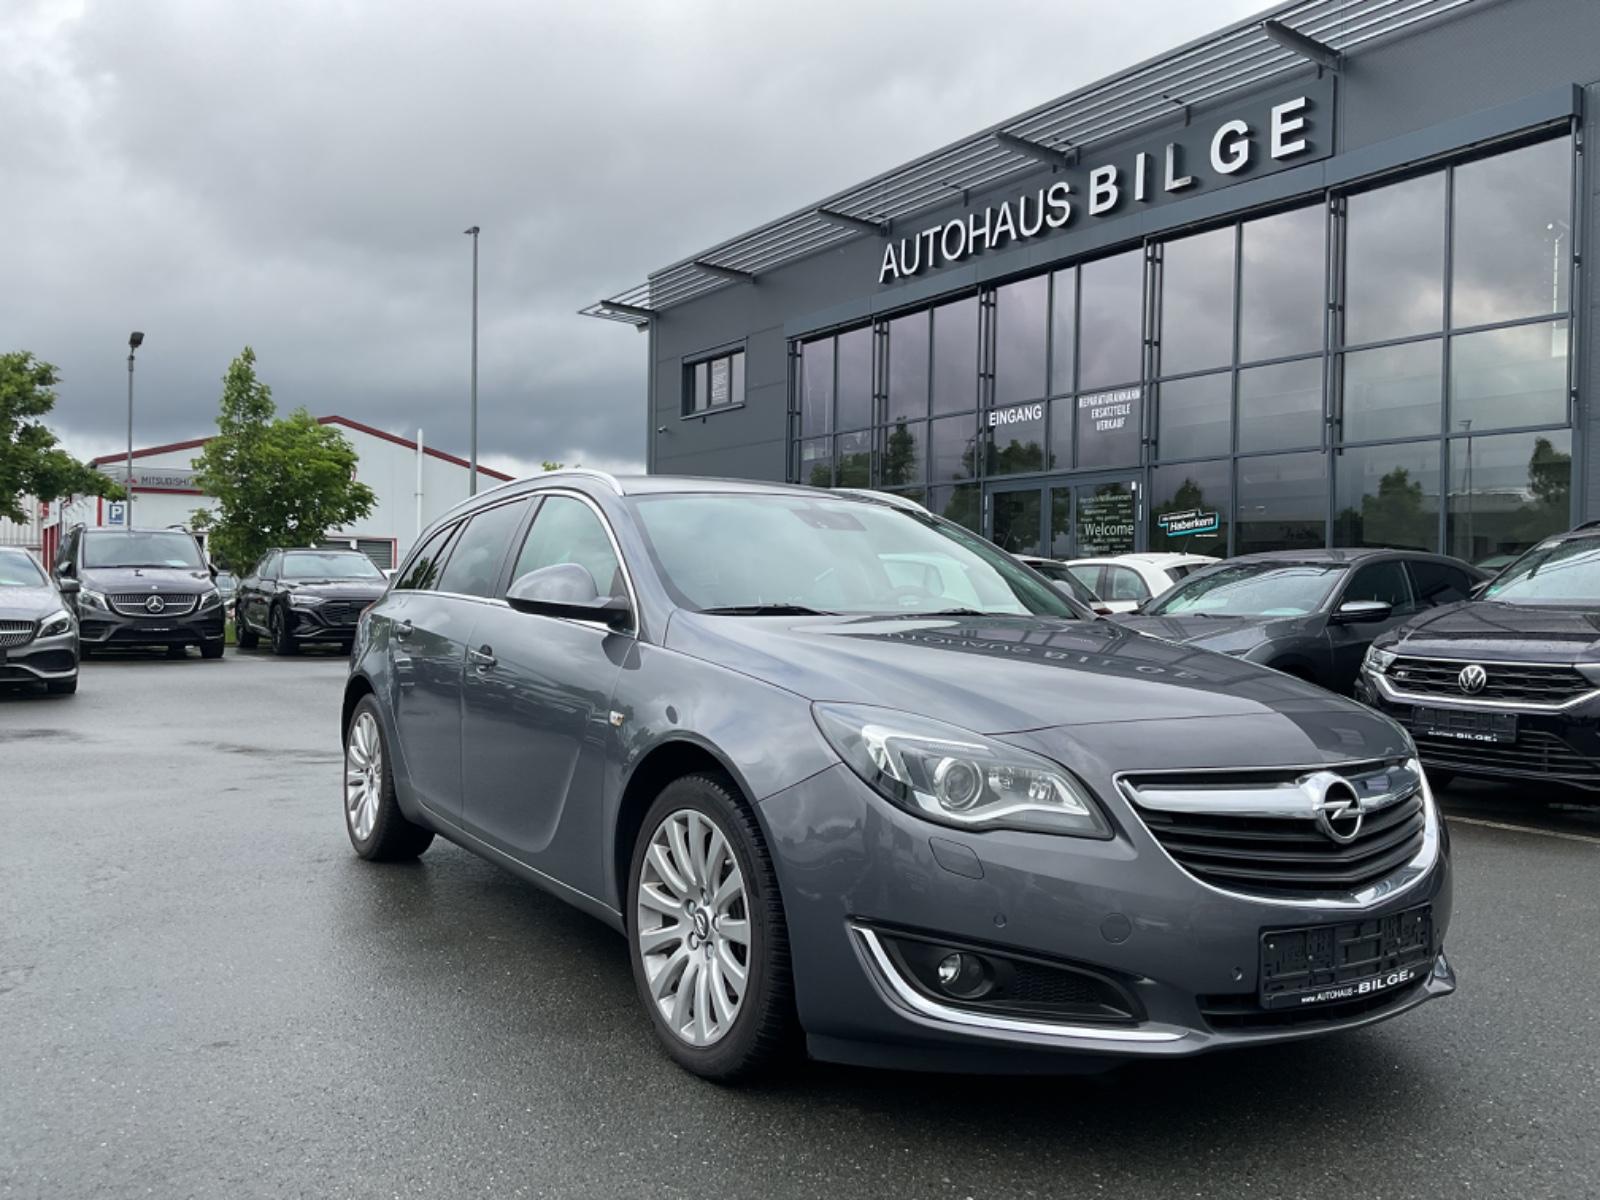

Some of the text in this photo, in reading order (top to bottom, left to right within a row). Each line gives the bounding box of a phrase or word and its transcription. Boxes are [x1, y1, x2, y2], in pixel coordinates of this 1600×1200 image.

[878, 95, 1310, 284] AUTOHAUS BILGE
[988, 404, 1042, 426] EINGANG
[1096, 417, 1126, 431] VERKAUF
[141, 475, 190, 486] MITSUBISHI
[111, 506, 122, 519] P
[1085, 522, 1134, 536] Welcome
